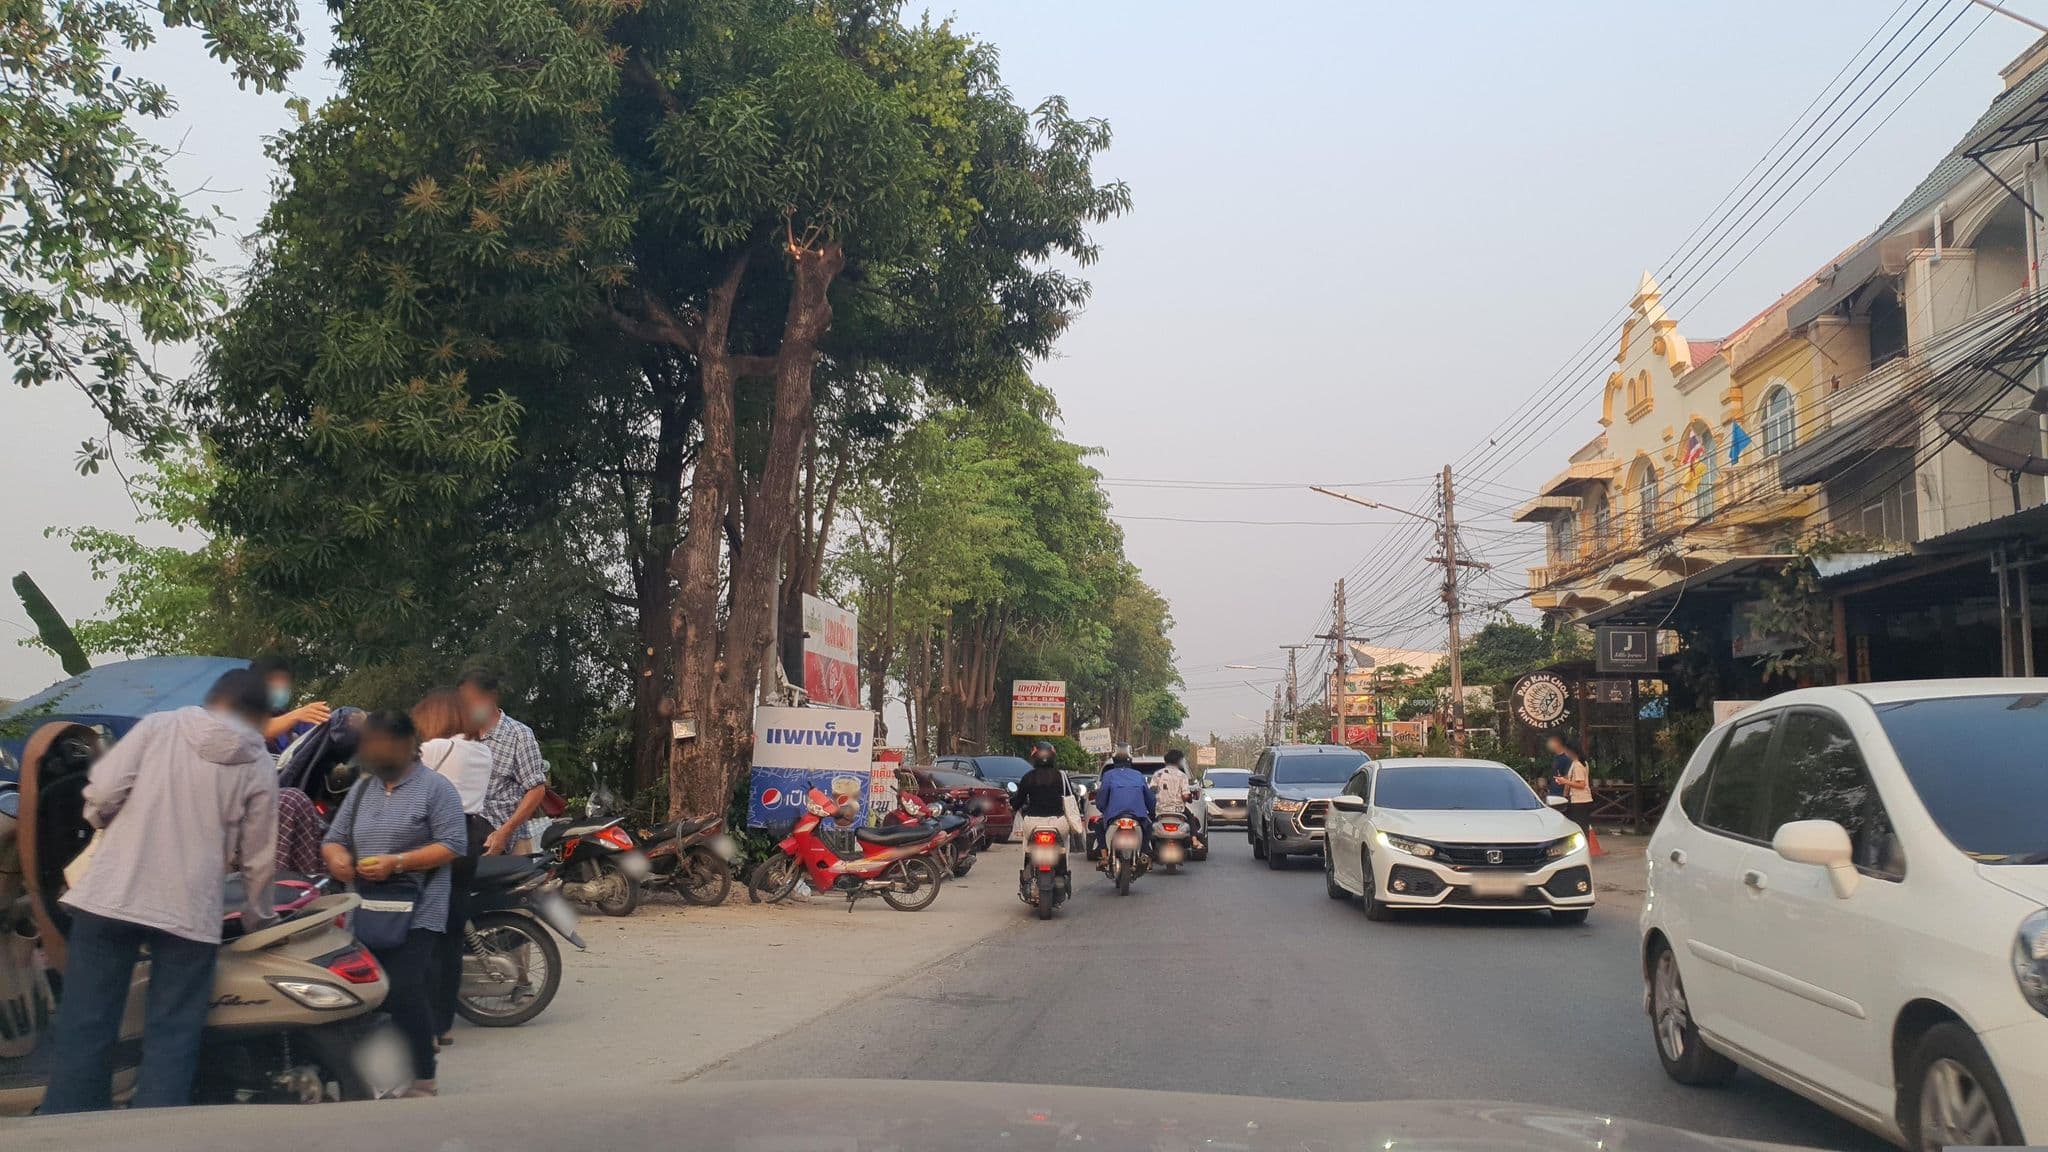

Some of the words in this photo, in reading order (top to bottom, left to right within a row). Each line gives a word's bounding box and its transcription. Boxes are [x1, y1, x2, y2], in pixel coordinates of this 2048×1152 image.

[1517, 680, 1531, 697] PAD
[1530, 675, 1550, 683] KAN
[1518, 706, 1548, 729] VINTAGE
[1551, 709, 1570, 728] STYLE
[766, 721, 862, 753] แพเพ็ญ
